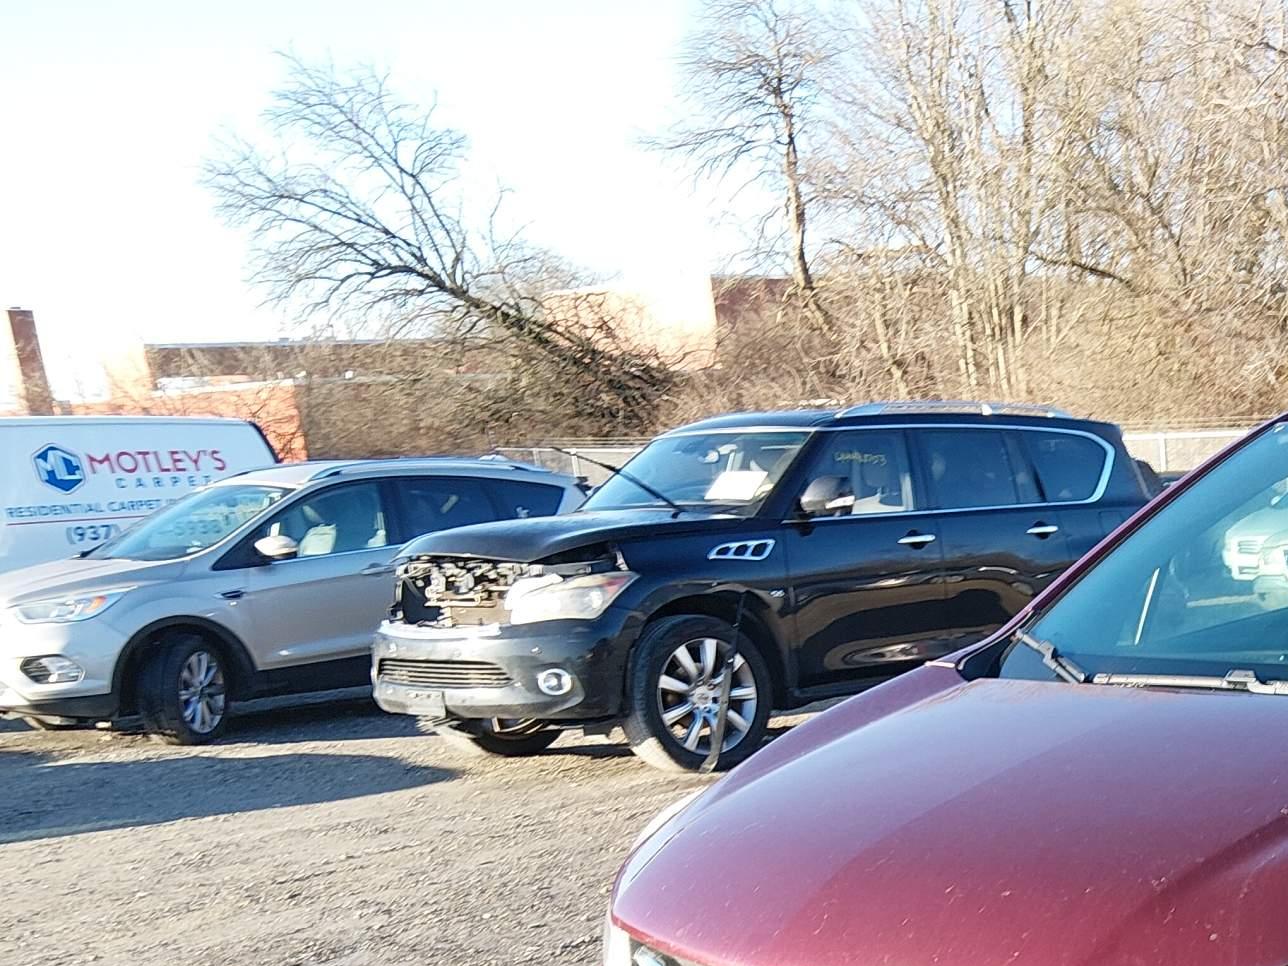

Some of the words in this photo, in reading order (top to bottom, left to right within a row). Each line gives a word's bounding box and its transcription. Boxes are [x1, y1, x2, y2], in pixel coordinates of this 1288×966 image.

[87, 449, 227, 474] MOTLEY'S
[115, 474, 211, 489] CARPET
[6, 503, 103, 518] RESIDENTIAL
[108, 499, 162, 512] CARPET
